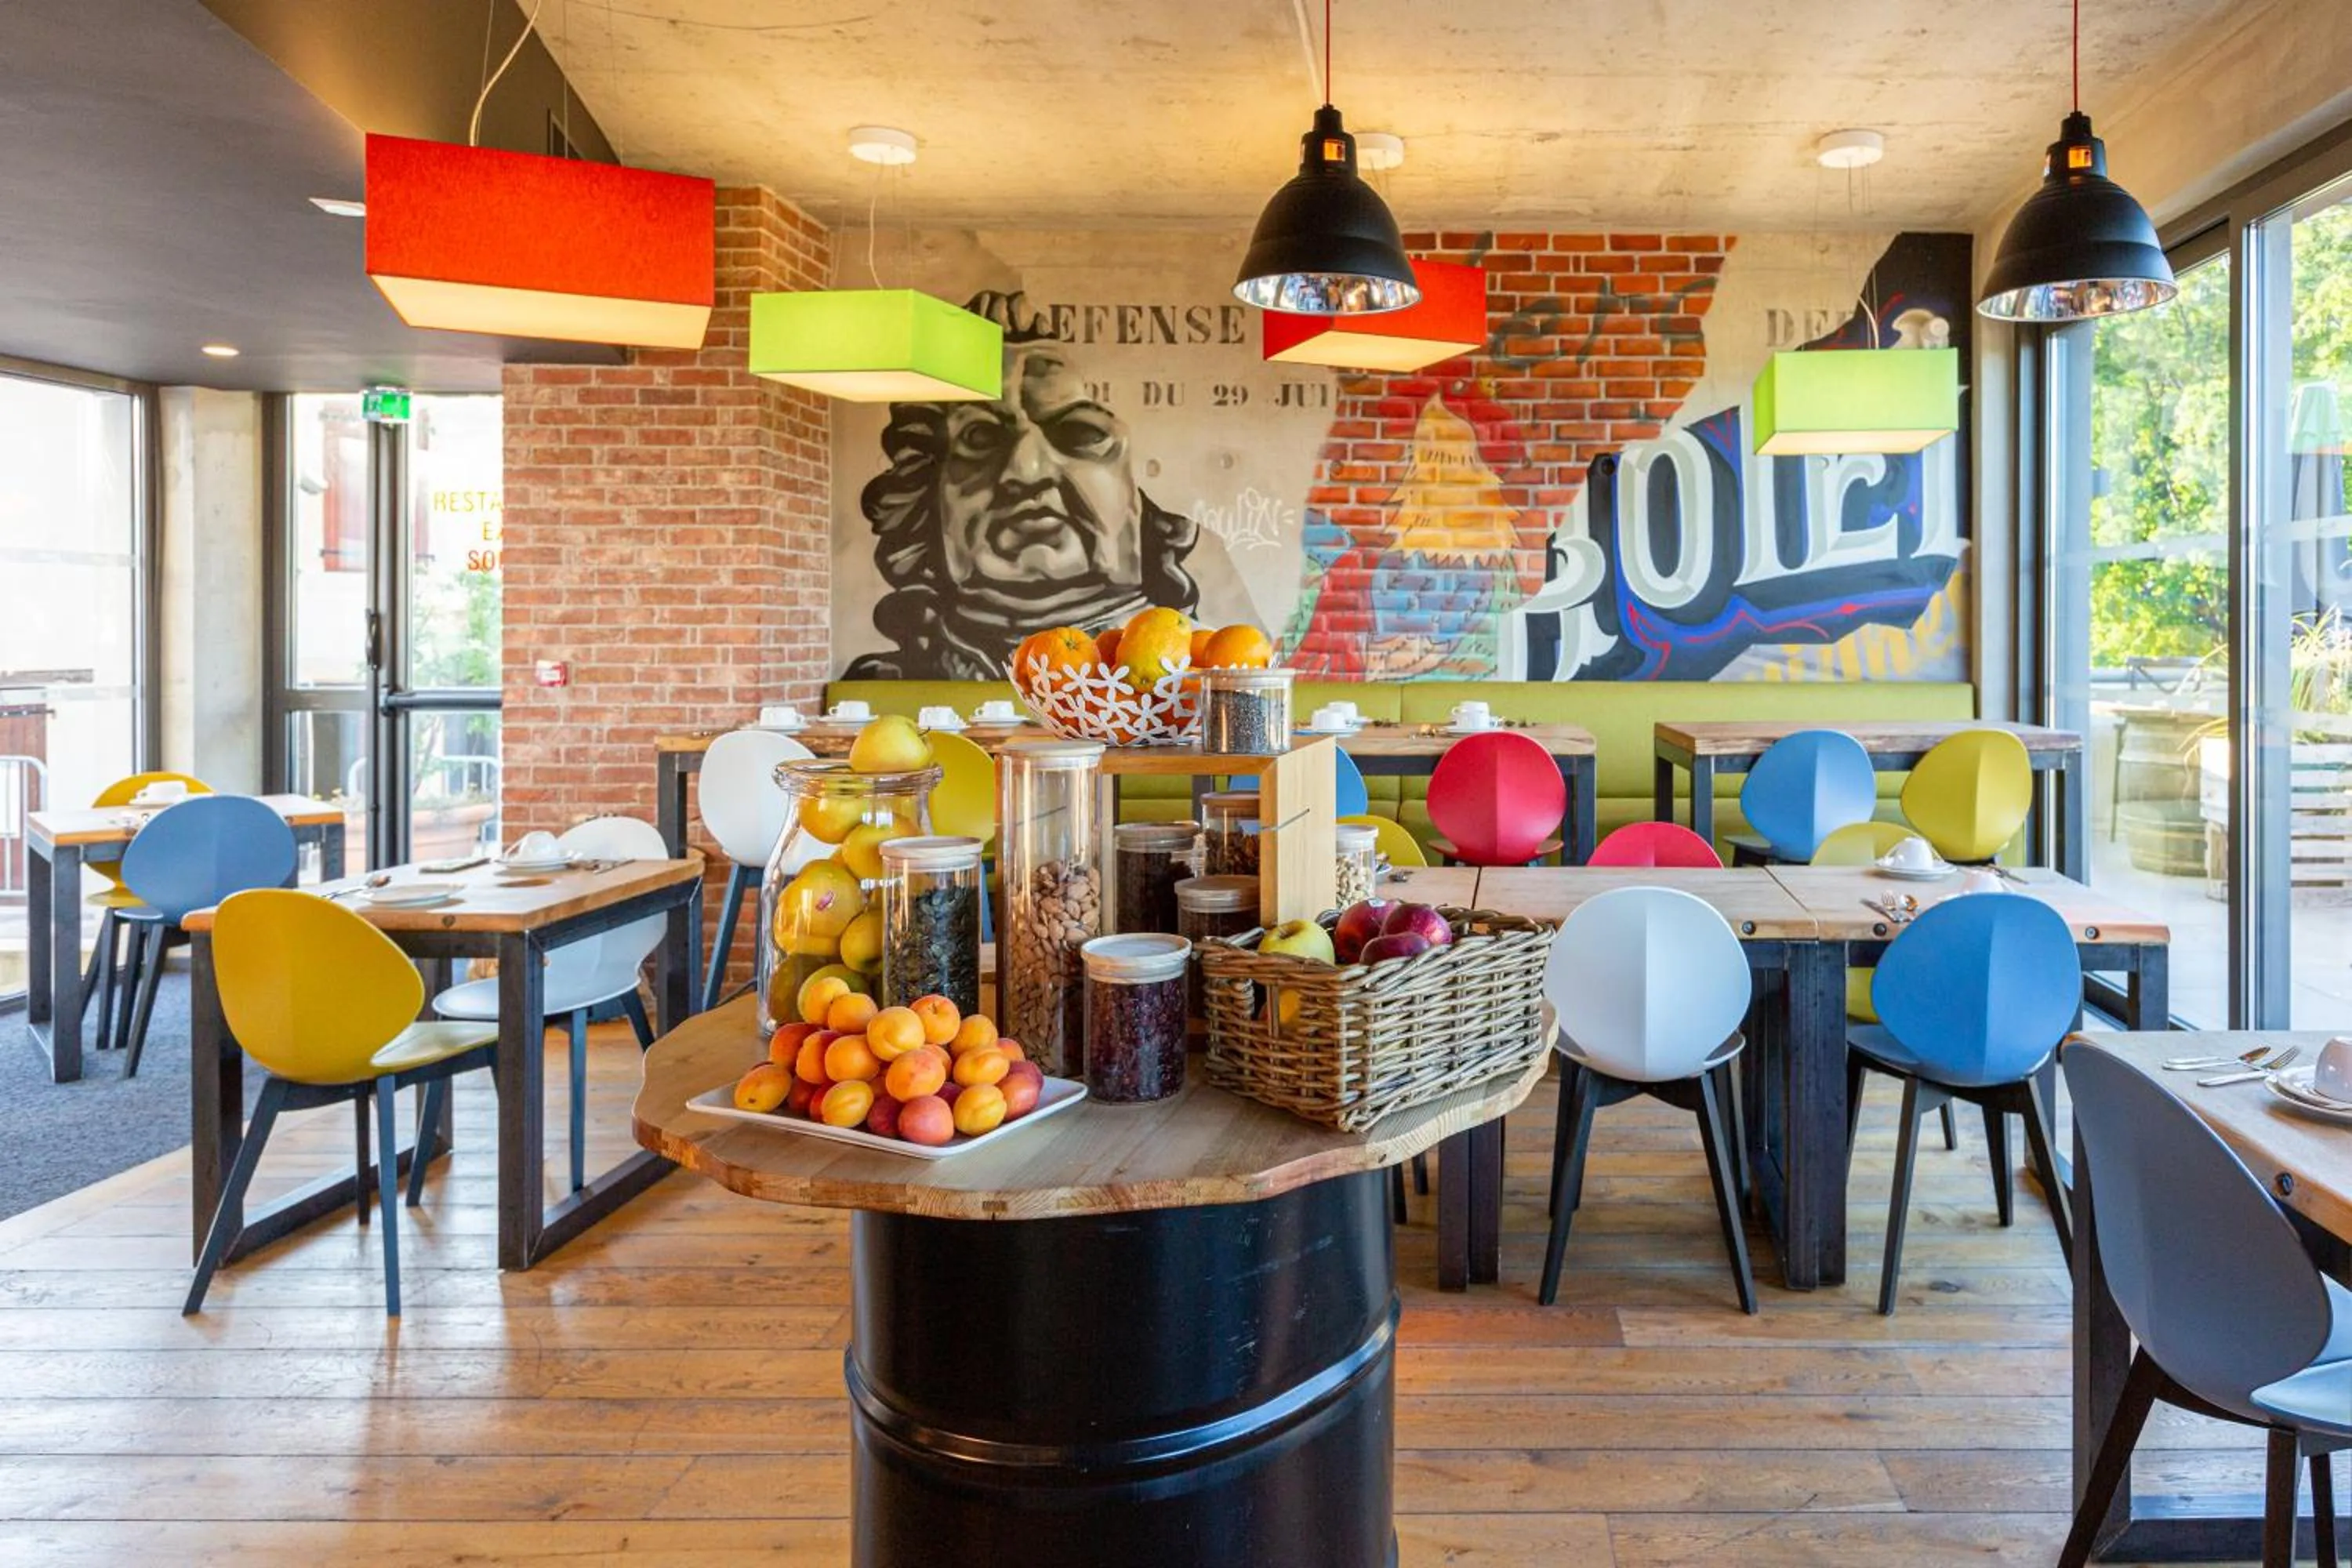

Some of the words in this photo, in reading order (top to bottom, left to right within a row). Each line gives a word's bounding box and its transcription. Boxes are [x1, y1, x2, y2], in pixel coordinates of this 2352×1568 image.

[1048, 303, 1246, 344] EFENSE
[1143, 382, 1185, 406] DU
[1213, 384, 1249, 407] 29
[467, 549, 503, 572] SO
